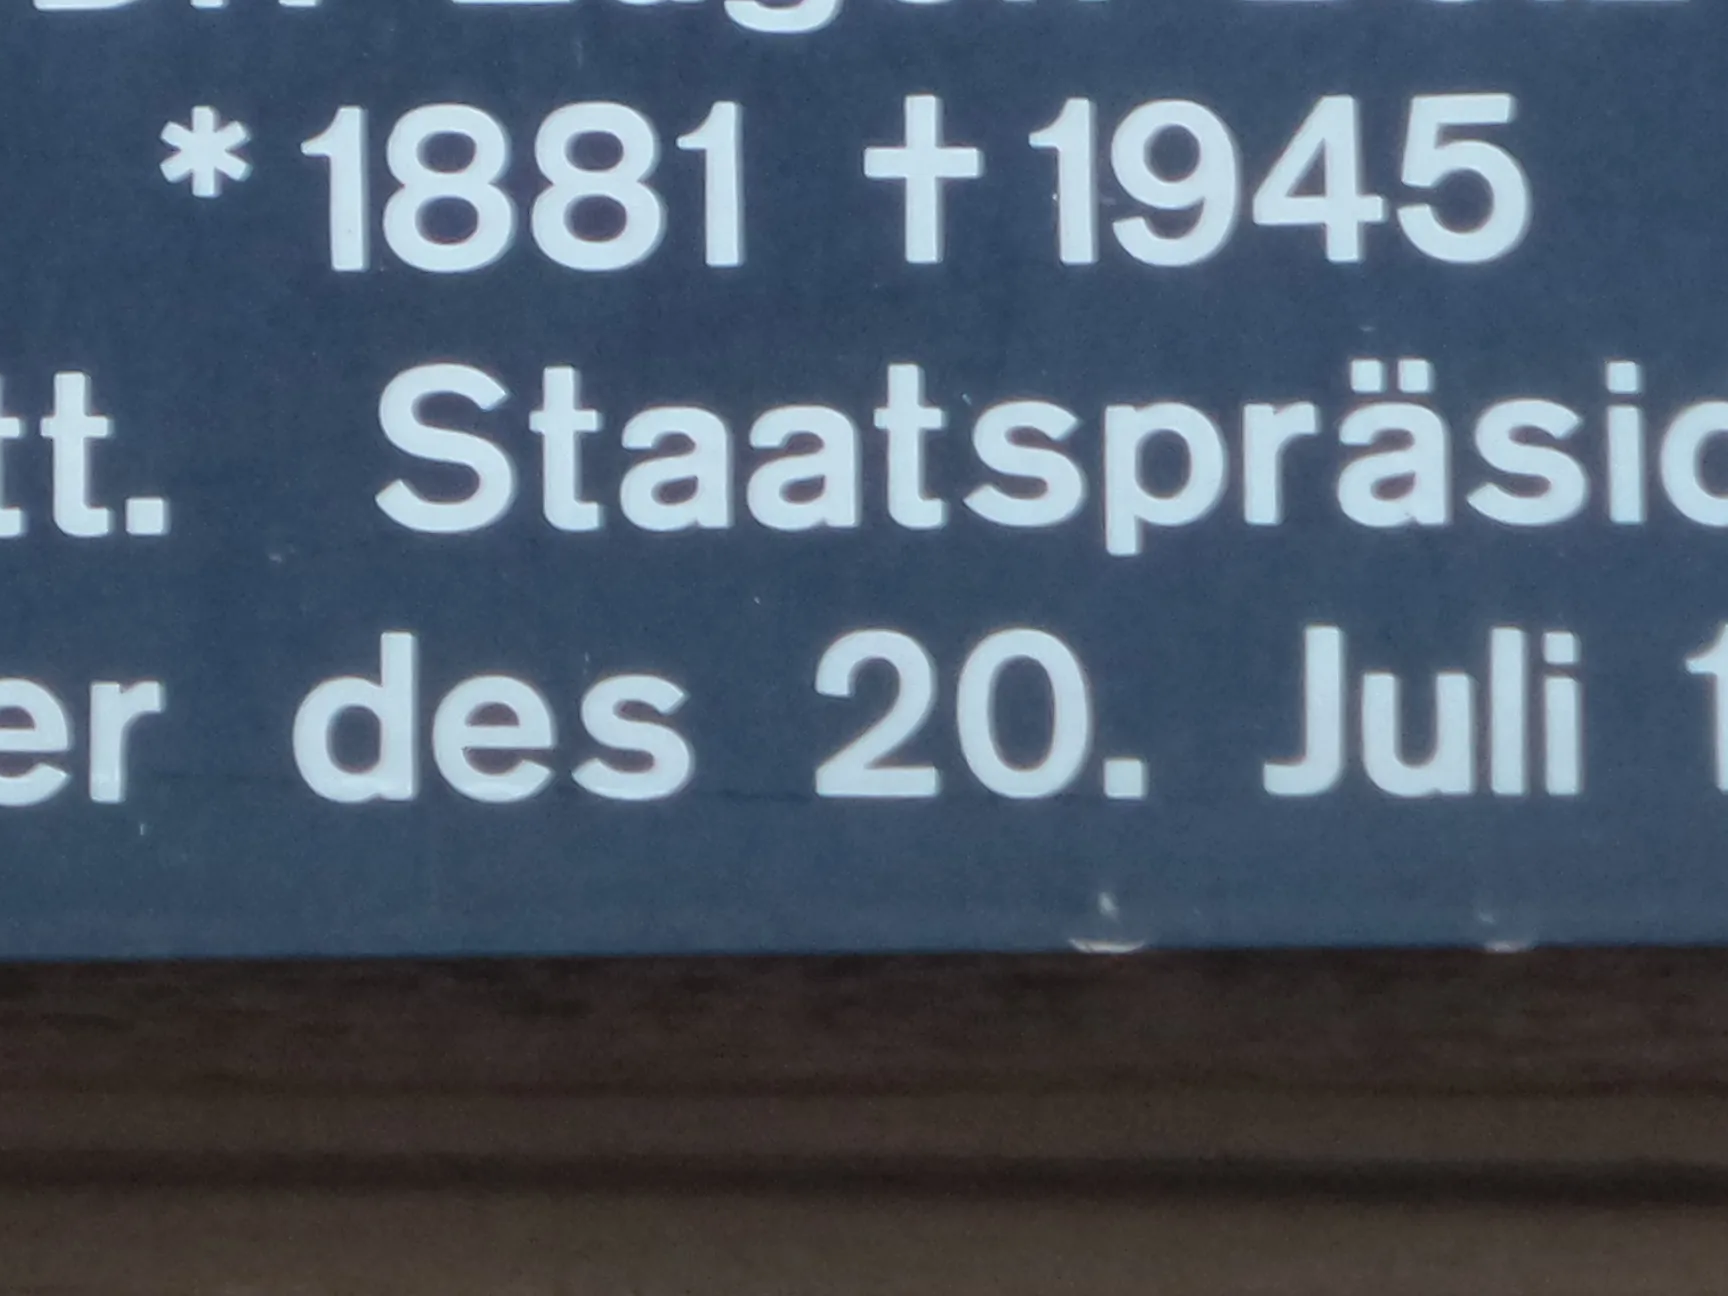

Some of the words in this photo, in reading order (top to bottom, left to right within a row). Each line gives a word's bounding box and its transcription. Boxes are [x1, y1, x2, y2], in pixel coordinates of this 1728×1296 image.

[292, 630, 693, 804] des
[814, 626, 1145, 800] 20.
[1262, 624, 1580, 798] Juli
